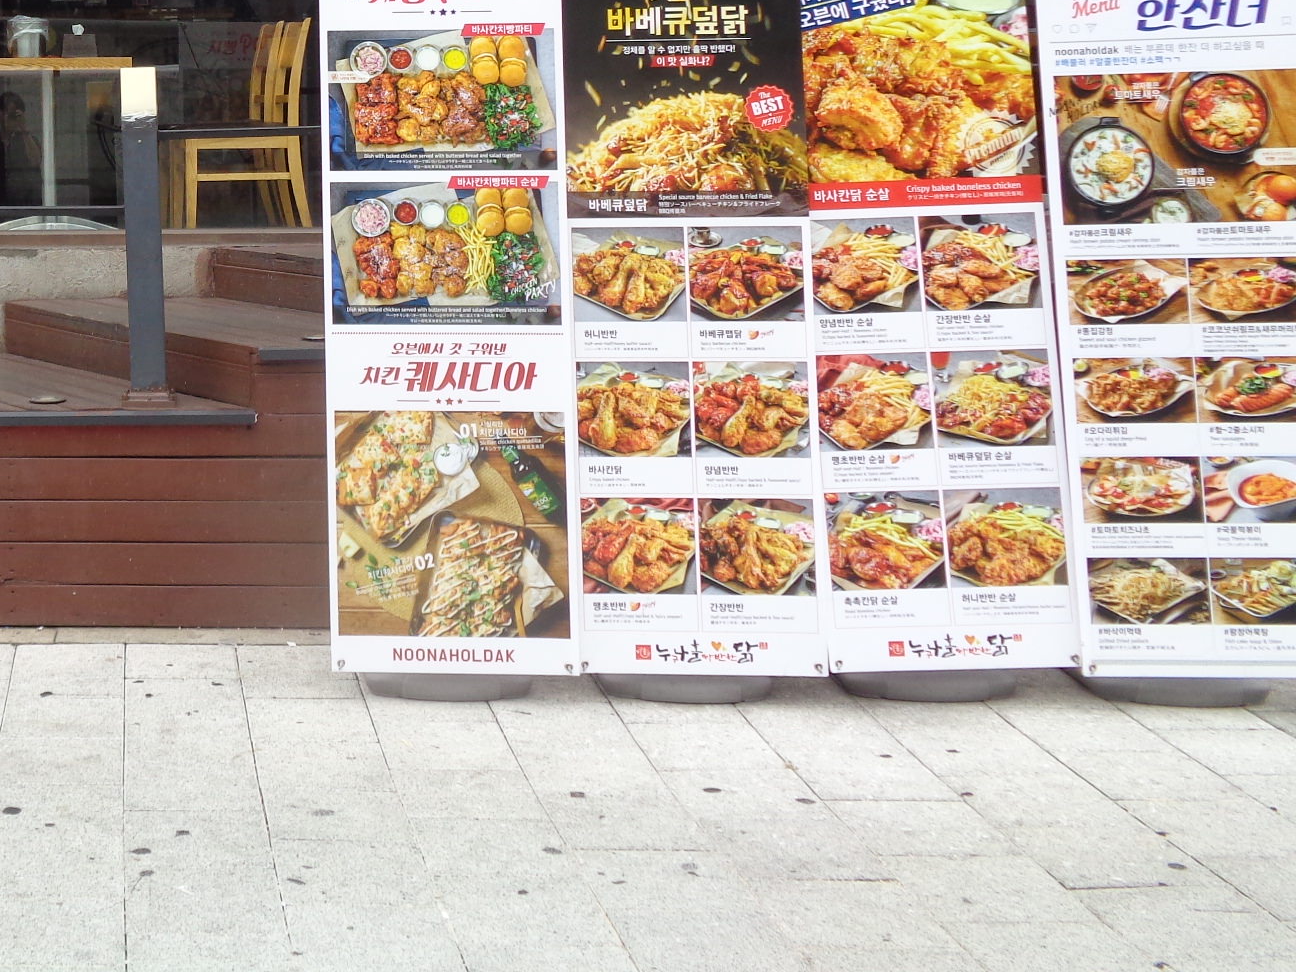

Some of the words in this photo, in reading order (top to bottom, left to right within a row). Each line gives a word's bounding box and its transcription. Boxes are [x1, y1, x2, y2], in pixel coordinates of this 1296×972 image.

[607, 4, 749, 37] 바베큐덮닭
[622, 45, 646, 55] 정체를
[647, 45, 656, 55] 알
[657, 46, 666, 54] 수
[1054, 45, 1120, 57] noonaholdak
[657, 57, 666, 66] 이
[667, 57, 677, 66] 맛
[759, 91, 772, 100] The
[751, 95, 784, 116] BEST
[760, 115, 784, 128] MENU
[520, 176, 539, 187] 순살
[813, 189, 863, 204] 바사칸닭
[864, 187, 891, 202] 순살
[906, 185, 931, 195] Crispy
[588, 199, 648, 212] 바베큐덮닭
[524, 278, 556, 302] PARTY
[583, 329, 618, 339] 허니반반
[391, 342, 445, 356] 오븐에서
[449, 342, 462, 356] 갓
[467, 342, 508, 356] 구워낸
[359, 366, 402, 386] 치킨
[459, 423, 478, 439] 01
[588, 465, 623, 475] 바사칸닭
[704, 465, 739, 476] 양념반반
[415, 552, 435, 571] 02
[709, 602, 744, 613] 간장반반
[392, 647, 516, 663] NOONAHOLDAK
